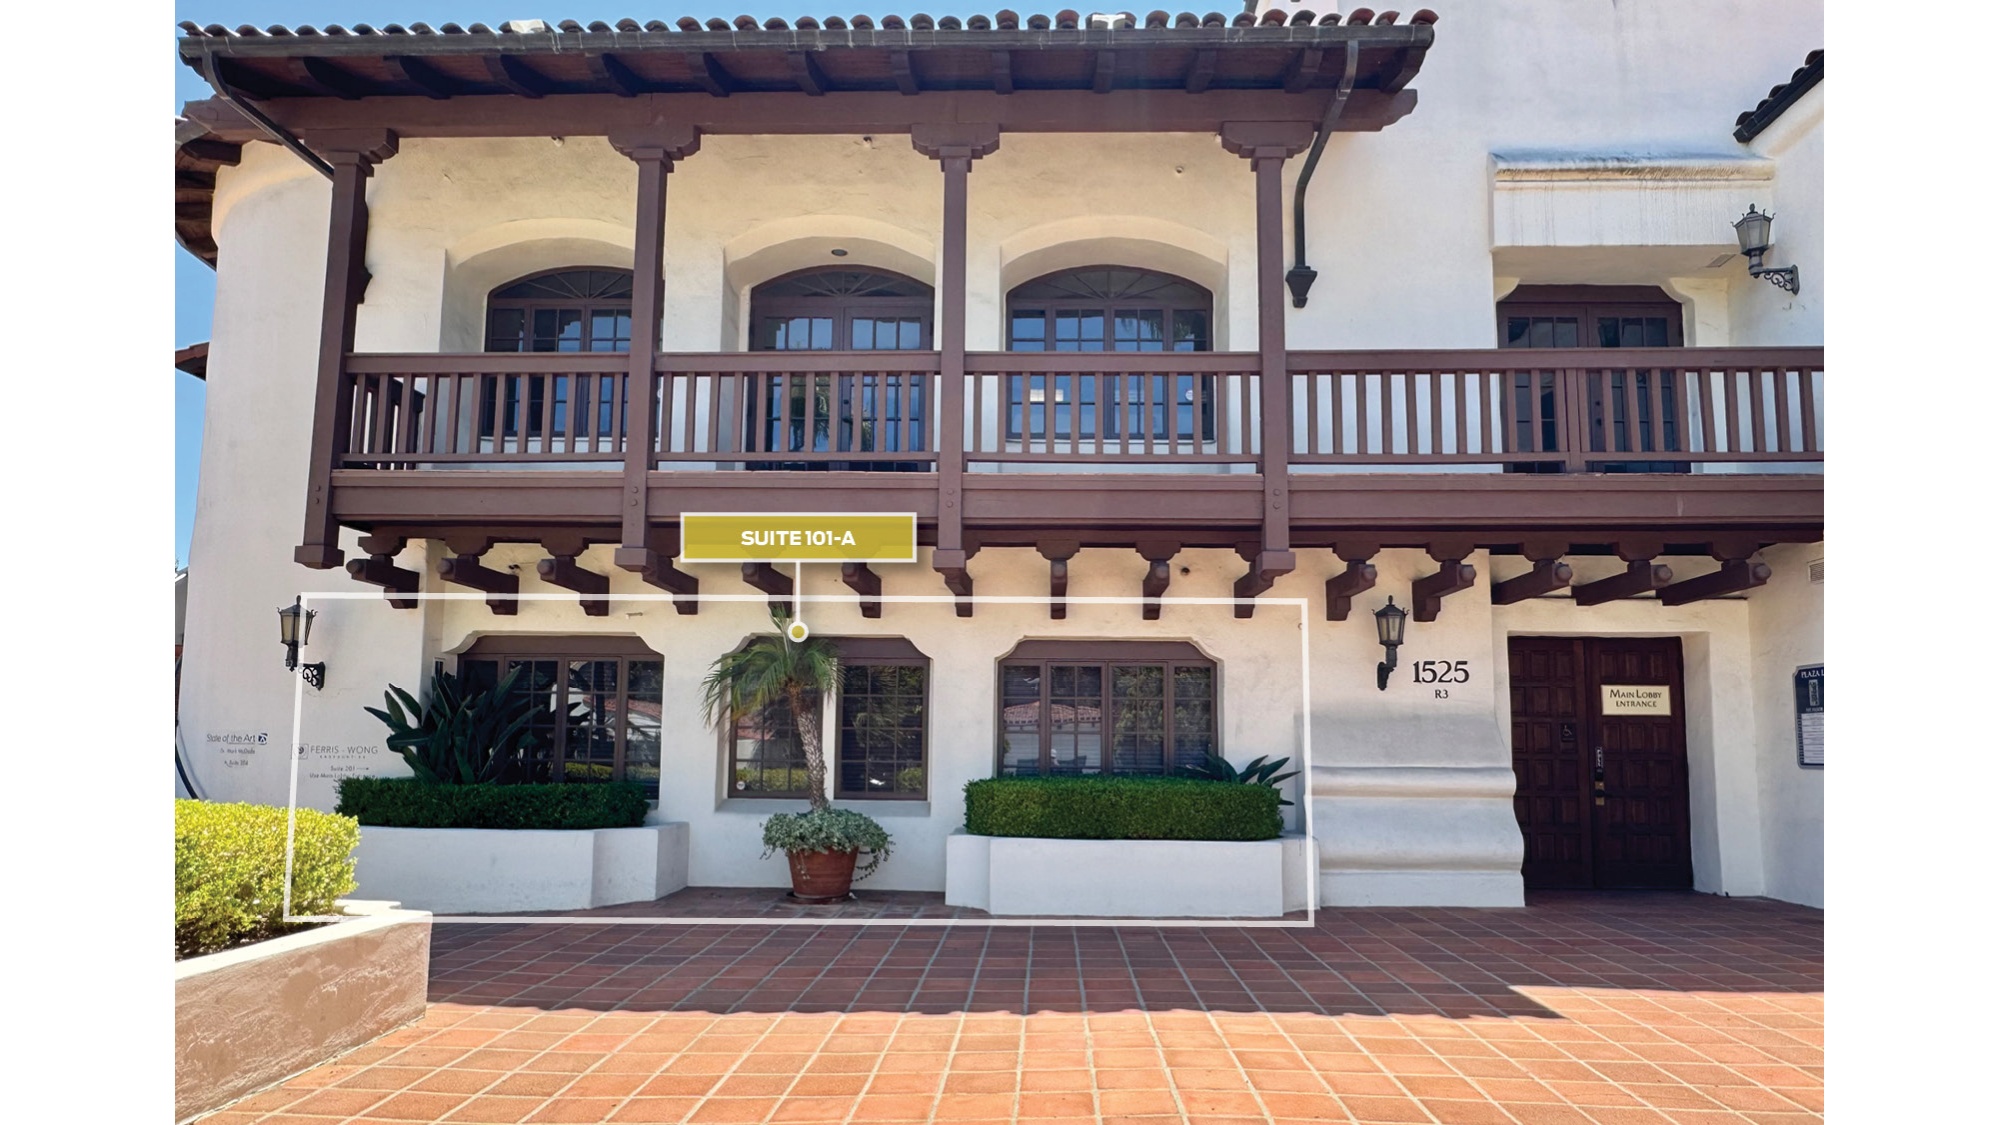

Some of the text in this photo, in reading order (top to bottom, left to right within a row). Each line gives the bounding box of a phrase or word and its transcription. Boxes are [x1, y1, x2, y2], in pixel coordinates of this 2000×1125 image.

[1412, 660, 1470, 684] 1525
[1801, 669, 1820, 679] PLAZA
[1434, 689, 1449, 699] R3
[1615, 700, 1658, 708] ENTRANCE
[243, 733, 256, 743] Art
[310, 745, 340, 755] FERRIS
[347, 745, 379, 755] WONG
